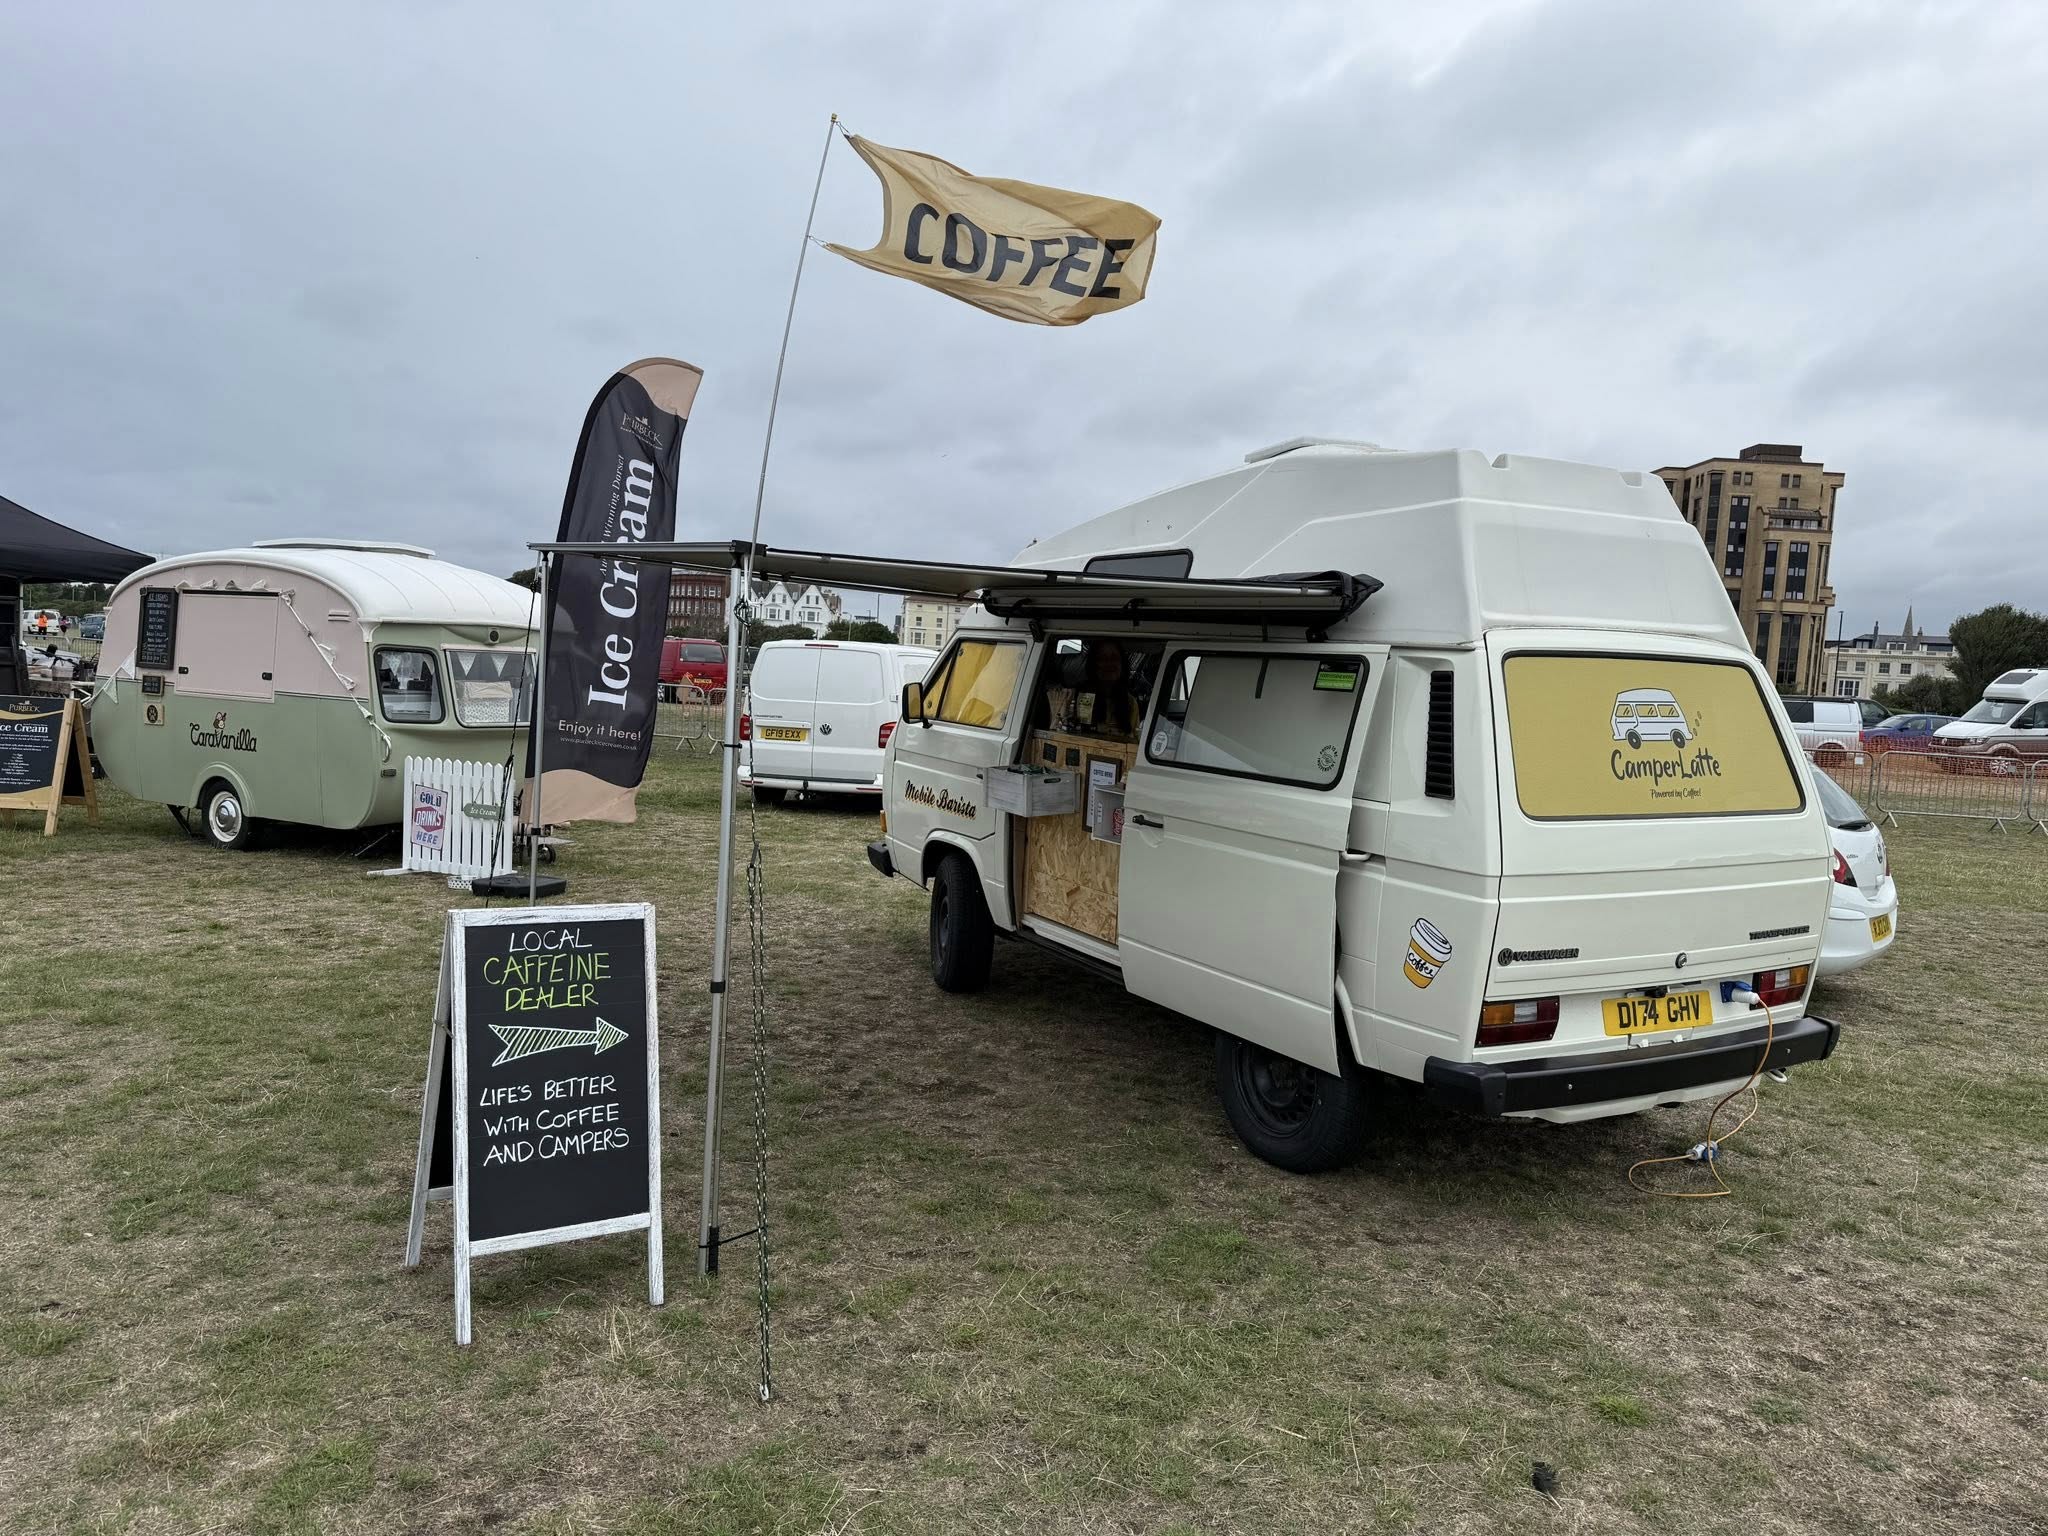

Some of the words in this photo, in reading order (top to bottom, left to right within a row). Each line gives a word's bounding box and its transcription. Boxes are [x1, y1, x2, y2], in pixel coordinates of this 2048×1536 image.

[904, 203, 1135, 299] COFFEE
[603, 493, 620, 537] Winning
[587, 633, 634, 711] Ice
[8, 703, 41, 713] PURBECK
[0, 723, 12, 732] ce
[14, 723, 49, 734] Cream
[189, 721, 258, 753] CaraVanilla
[558, 719, 593, 737] Enjoy
[597, 723, 605, 736] it
[609, 725, 641, 741] here!
[765, 728, 784, 738] GF19
[784, 729, 801, 739] EXX
[1610, 747, 1722, 786] CamperLatte
[420, 792, 442, 807] COLD
[904, 779, 936, 808] Mobile
[936, 788, 977, 820] Barista
[1650, 788, 1675, 800] Powered
[1674, 789, 1683, 800] by
[415, 810, 441, 827] DRINKS
[416, 831, 438, 844] HERE
[509, 928, 593, 953] LOCAL
[1513, 947, 1580, 962] VOLKSWAGEN
[483, 952, 612, 985] CAFFEINE
[505, 983, 600, 1012] DEALER
[1618, 1001, 1660, 1029] D174
[1666, 994, 1701, 1023] GHV
[479, 1084, 533, 1107] LIFE'S
[543, 1074, 617, 1101] BETTER
[483, 1115, 530, 1137] WITH
[536, 1102, 620, 1130] COFFEE
[483, 1140, 534, 1167] AND
[538, 1127, 630, 1159] CAMPERS
